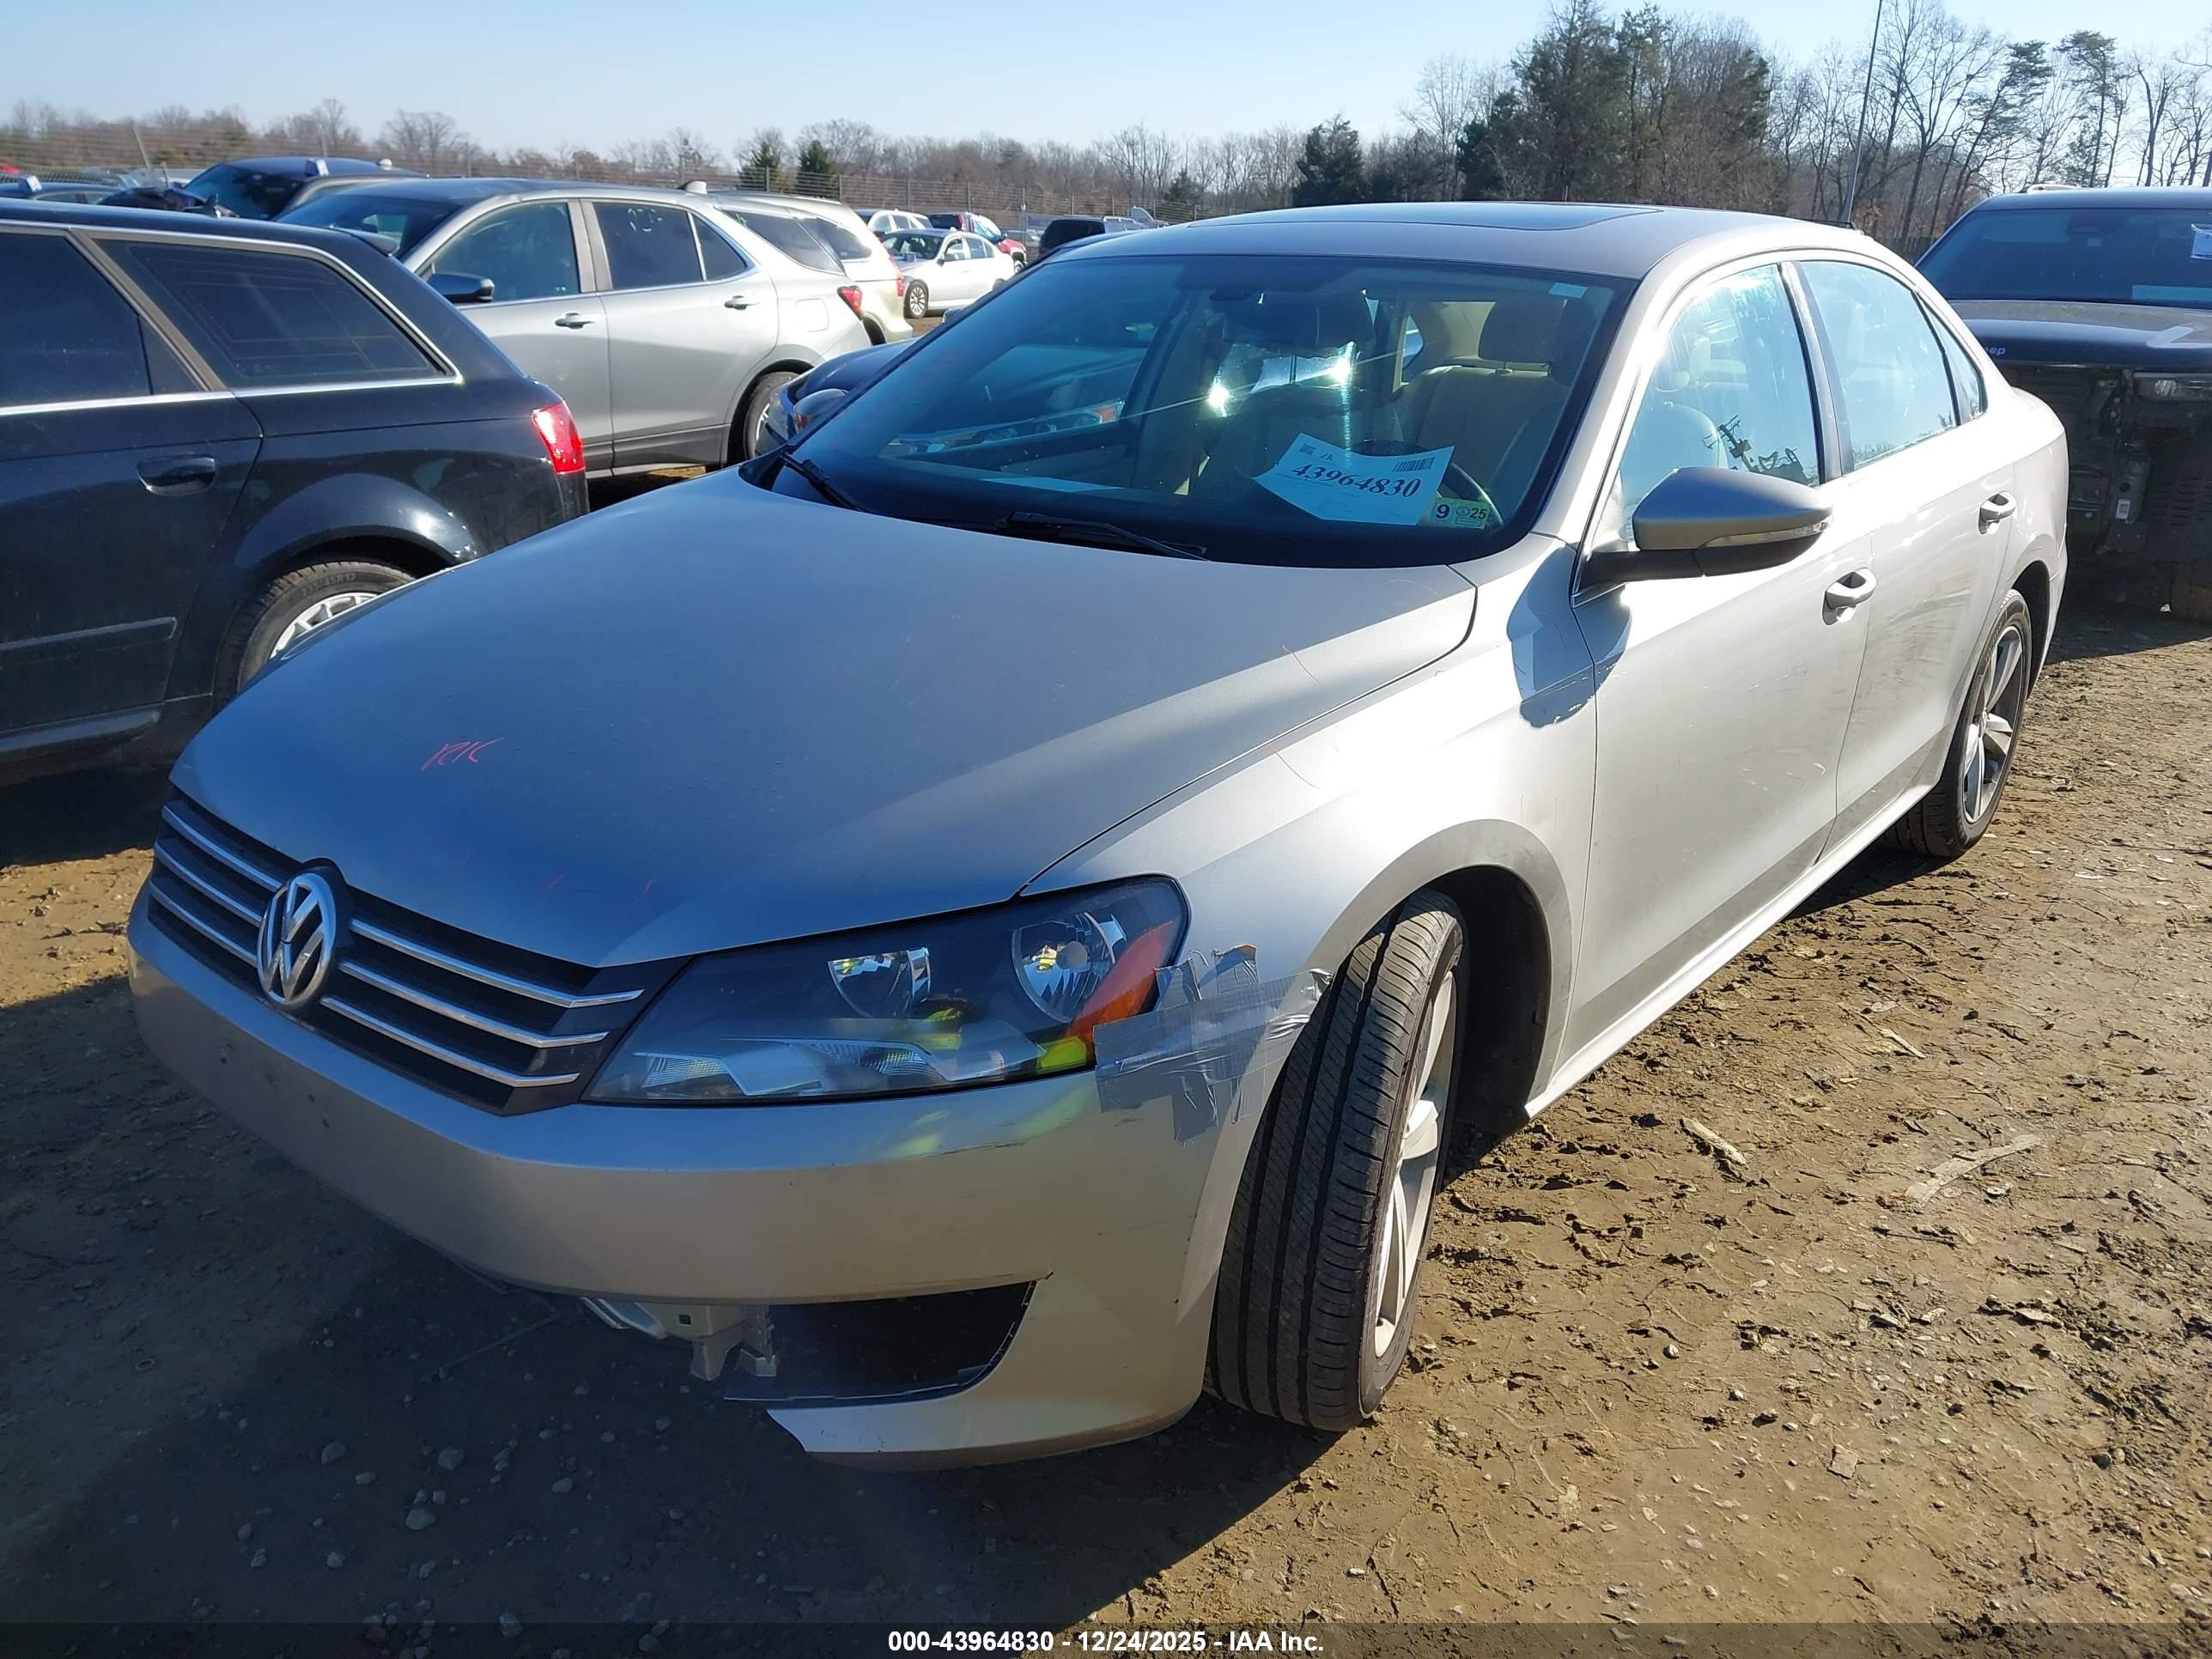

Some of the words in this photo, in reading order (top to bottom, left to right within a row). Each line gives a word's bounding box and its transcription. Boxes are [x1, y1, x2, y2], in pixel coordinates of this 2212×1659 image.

[1291, 464, 1421, 498] 43964830
[1436, 504, 1450, 519] 9
[1469, 507, 1487, 520] 25
